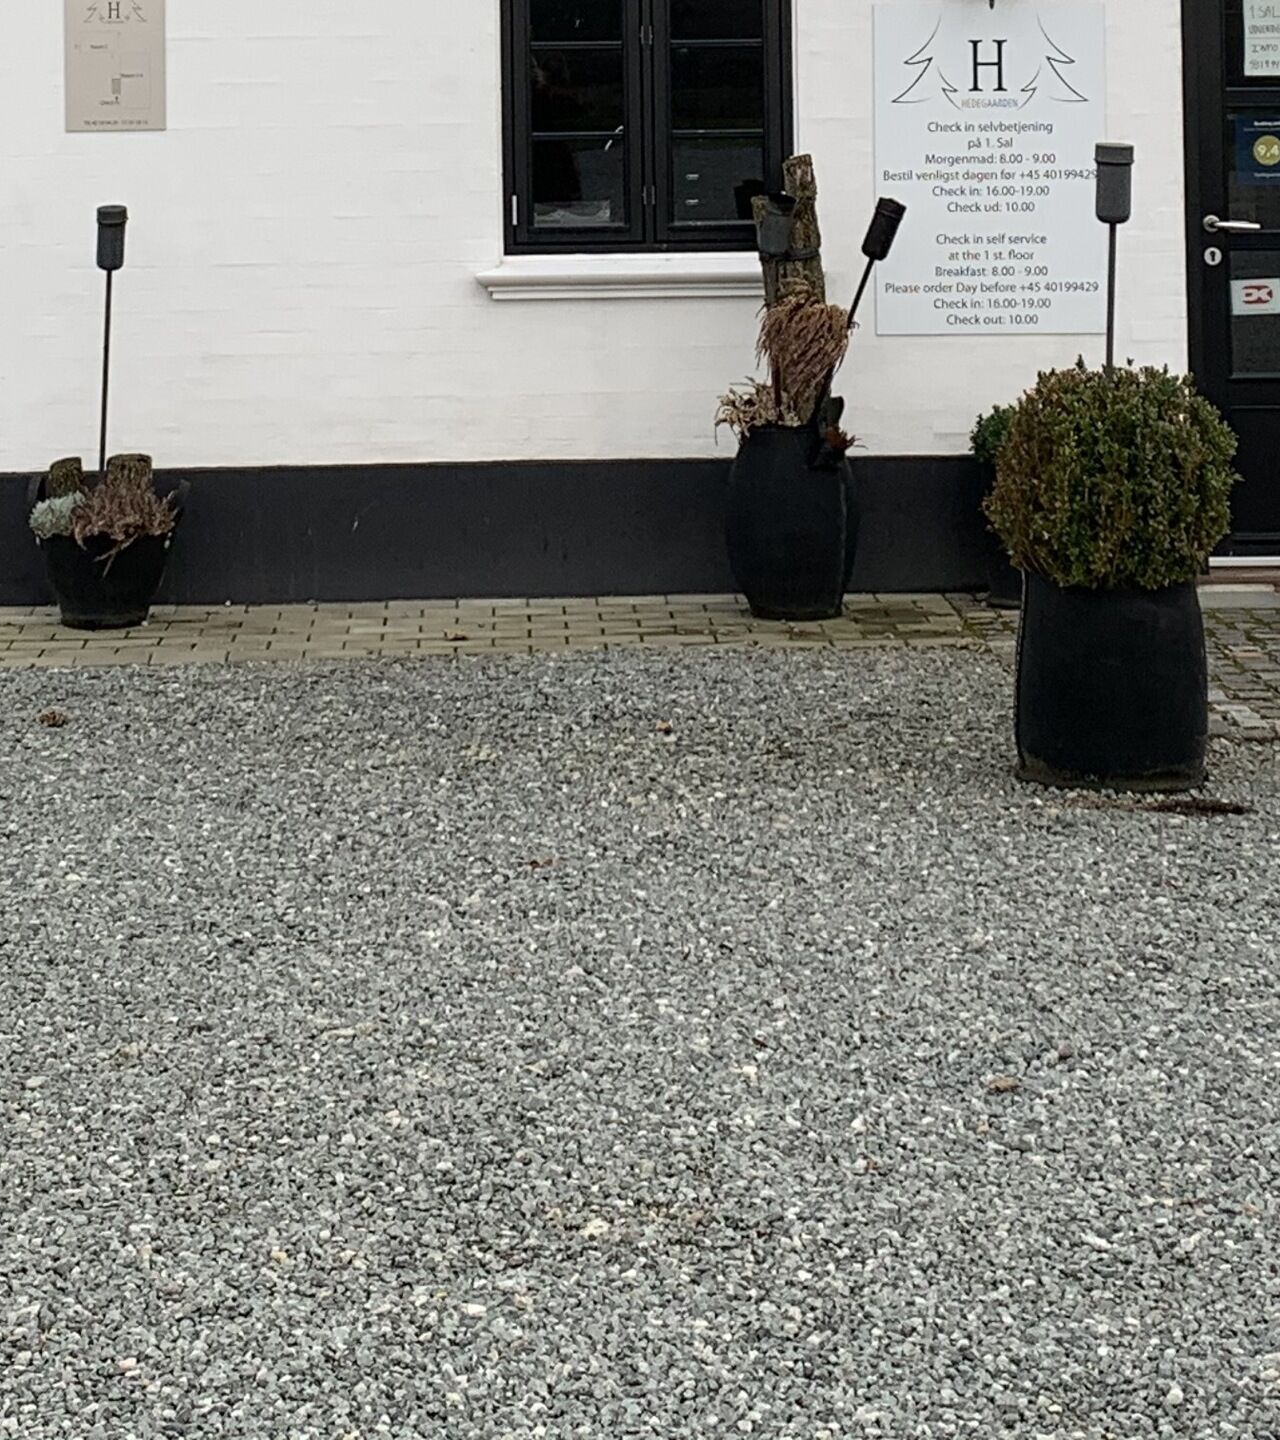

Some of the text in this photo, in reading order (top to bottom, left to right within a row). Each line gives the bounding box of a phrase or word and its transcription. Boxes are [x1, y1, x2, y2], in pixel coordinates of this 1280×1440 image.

[108, 1, 120, 19] H
[968, 39, 1007, 92] H
[927, 121, 1053, 134] Check in selvbetjening
[968, 137, 981, 150] på
[997, 137, 1013, 148] Sal
[1257, 145, 1280, 158] 9,4
[925, 153, 997, 167] Morgenmad:
[999, 153, 1023, 164] 8.00
[1032, 153, 1056, 164] 9.00
[883, 170, 913, 181] Bestil
[915, 170, 959, 183] venligst
[962, 169, 997, 183] dagen
[1020, 170, 1040, 179] +45
[932, 185, 1050, 196] Check in: 16.00-19.00
[947, 201, 1035, 212] Check ud: 10.00
[936, 233, 1047, 245] Check in self service
[948, 252, 959, 261] at
[962, 250, 981, 261] the
[1008, 249, 1034, 260] floor
[992, 266, 1015, 276] 8.00
[1024, 266, 1048, 276] 9.00
[885, 281, 1099, 295] Please order Day before +45 40199429
[934, 298, 1051, 309] Check in: 16.00-19.00
[946, 314, 1039, 325] Check out: 10.00
